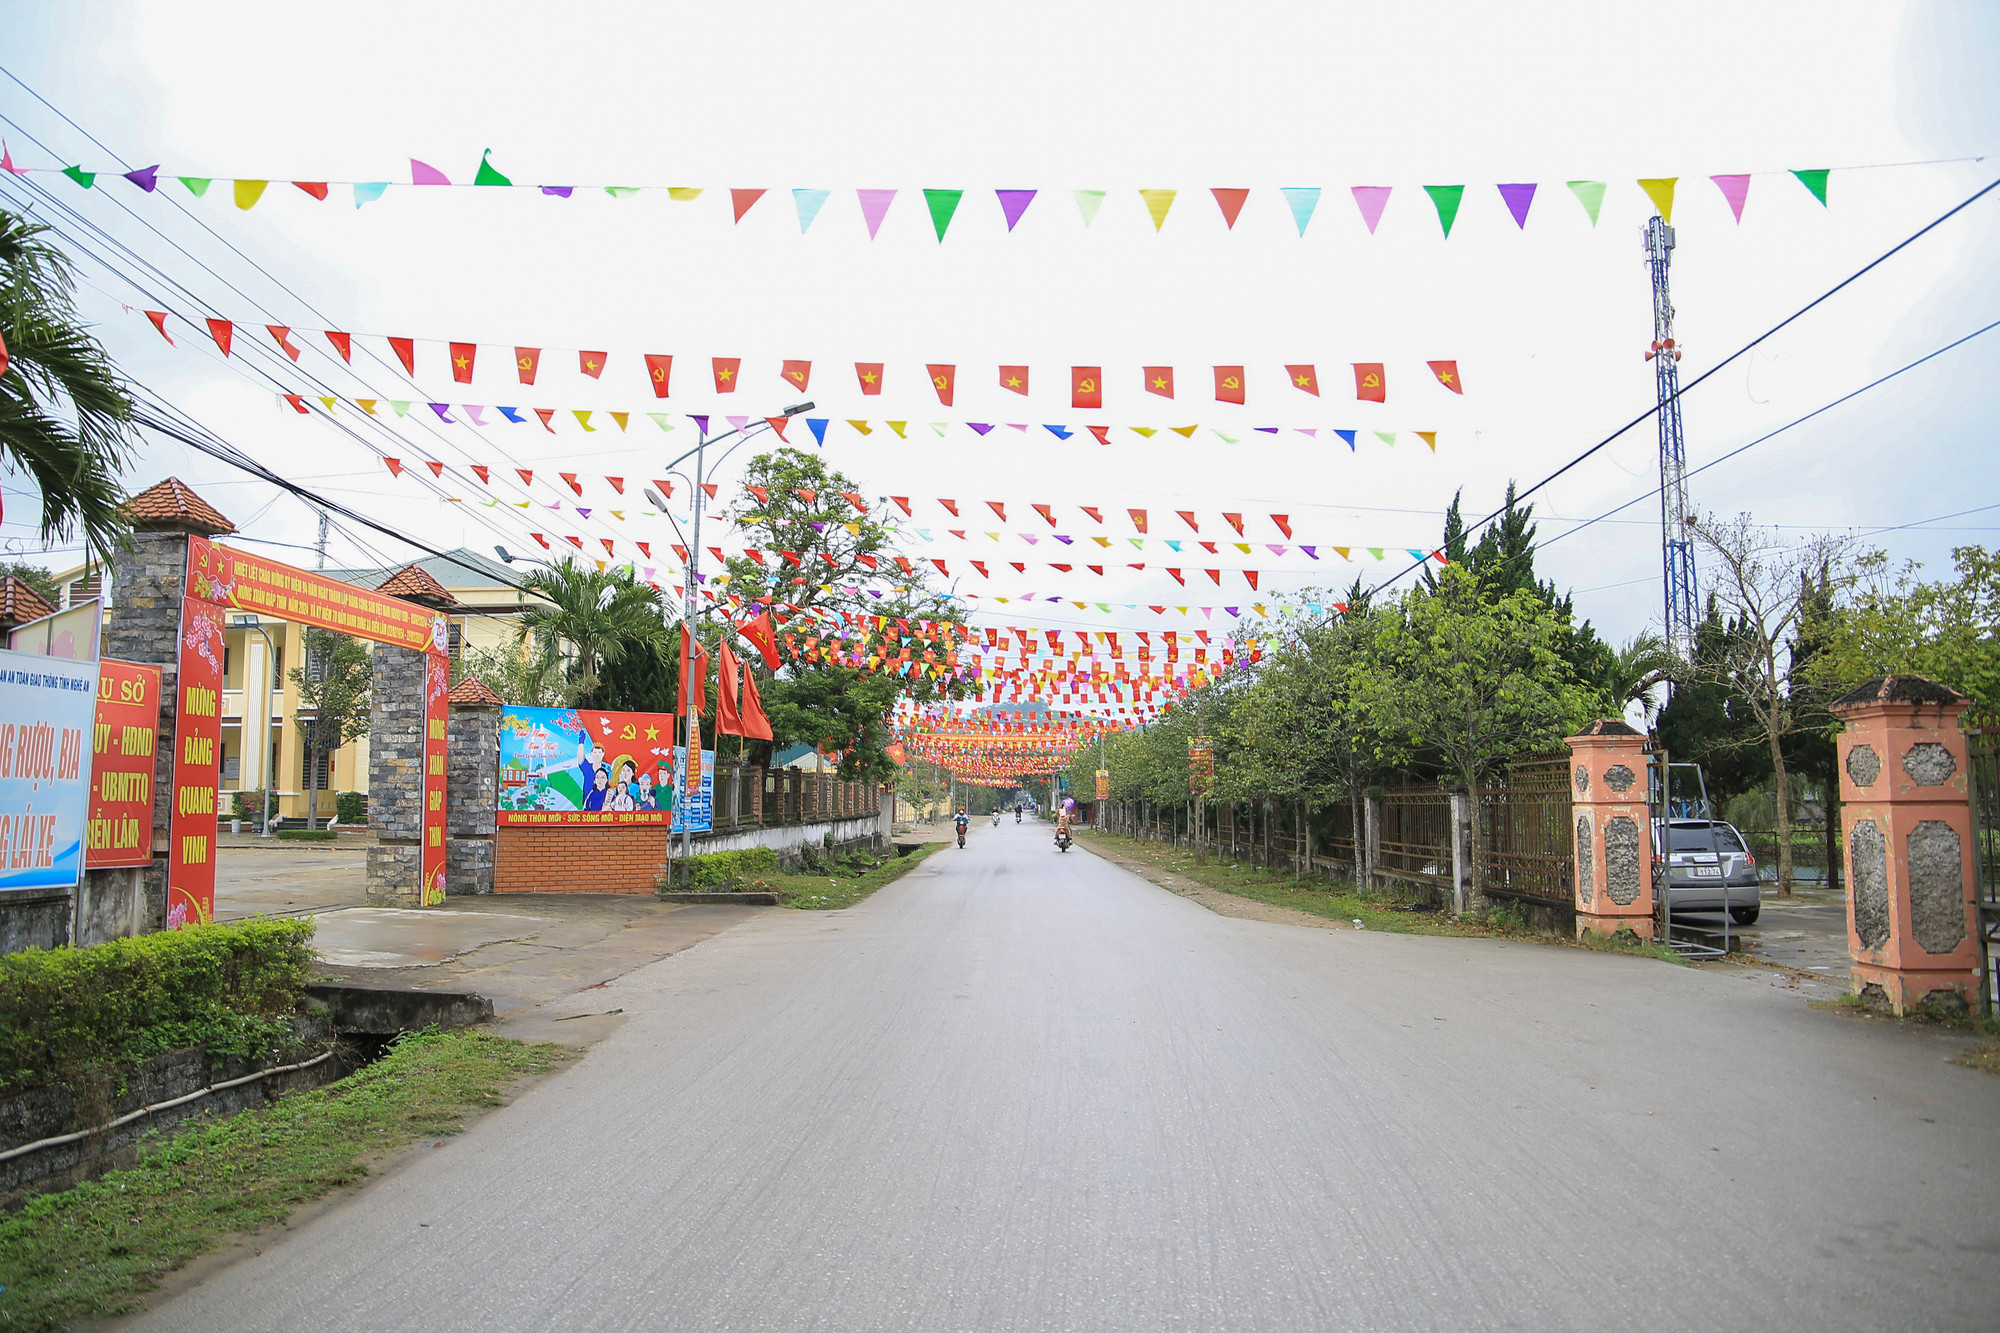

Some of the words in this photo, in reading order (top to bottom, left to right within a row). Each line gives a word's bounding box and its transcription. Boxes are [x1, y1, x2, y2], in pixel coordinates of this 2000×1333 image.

[248, 563, 258, 582] LIỆT
[8, 670, 15, 683] AN
[16, 669, 29, 685] TOÀN
[29, 673, 41, 687] GIAO
[42, 672, 58, 688] THÔNG
[59, 674, 70, 689] TỈNH
[70, 676, 82, 694] NGHỆ
[83, 680, 90, 692] AN
[97, 677, 114, 704] Ụ
[121, 674, 145, 702] SỞ
[186, 682, 216, 717] MỪNG
[94, 713, 111, 754] ỦY
[121, 726, 153, 757] HĐND
[429, 715, 445, 740] MỪNG
[15, 720, 55, 791] RƯỢU,
[58, 728, 82, 779] BIA
[184, 727, 213, 765] ĐẢNG
[429, 751, 444, 775] XUÂN
[102, 772, 149, 805] UBMTTQ
[179, 786, 214, 818] QUANG
[430, 786, 442, 811] GIÁP
[114, 812, 139, 848] LÂM
[508, 812, 527, 822] NÔNG
[529, 813, 547, 822] THÔN
[549, 812, 562, 822] MỚI
[567, 812, 580, 822] SỨC
[582, 812, 600, 822] SỐNG
[601, 812, 613, 822] MỚI
[619, 812, 634, 823] DIỆN
[635, 814, 649, 823] MẠO
[651, 812, 663, 822] MỚI
[11, 803, 36, 868] LÁI
[35, 815, 56, 867] XE
[429, 822, 441, 847] THÌN
[182, 836, 207, 864] VINH
